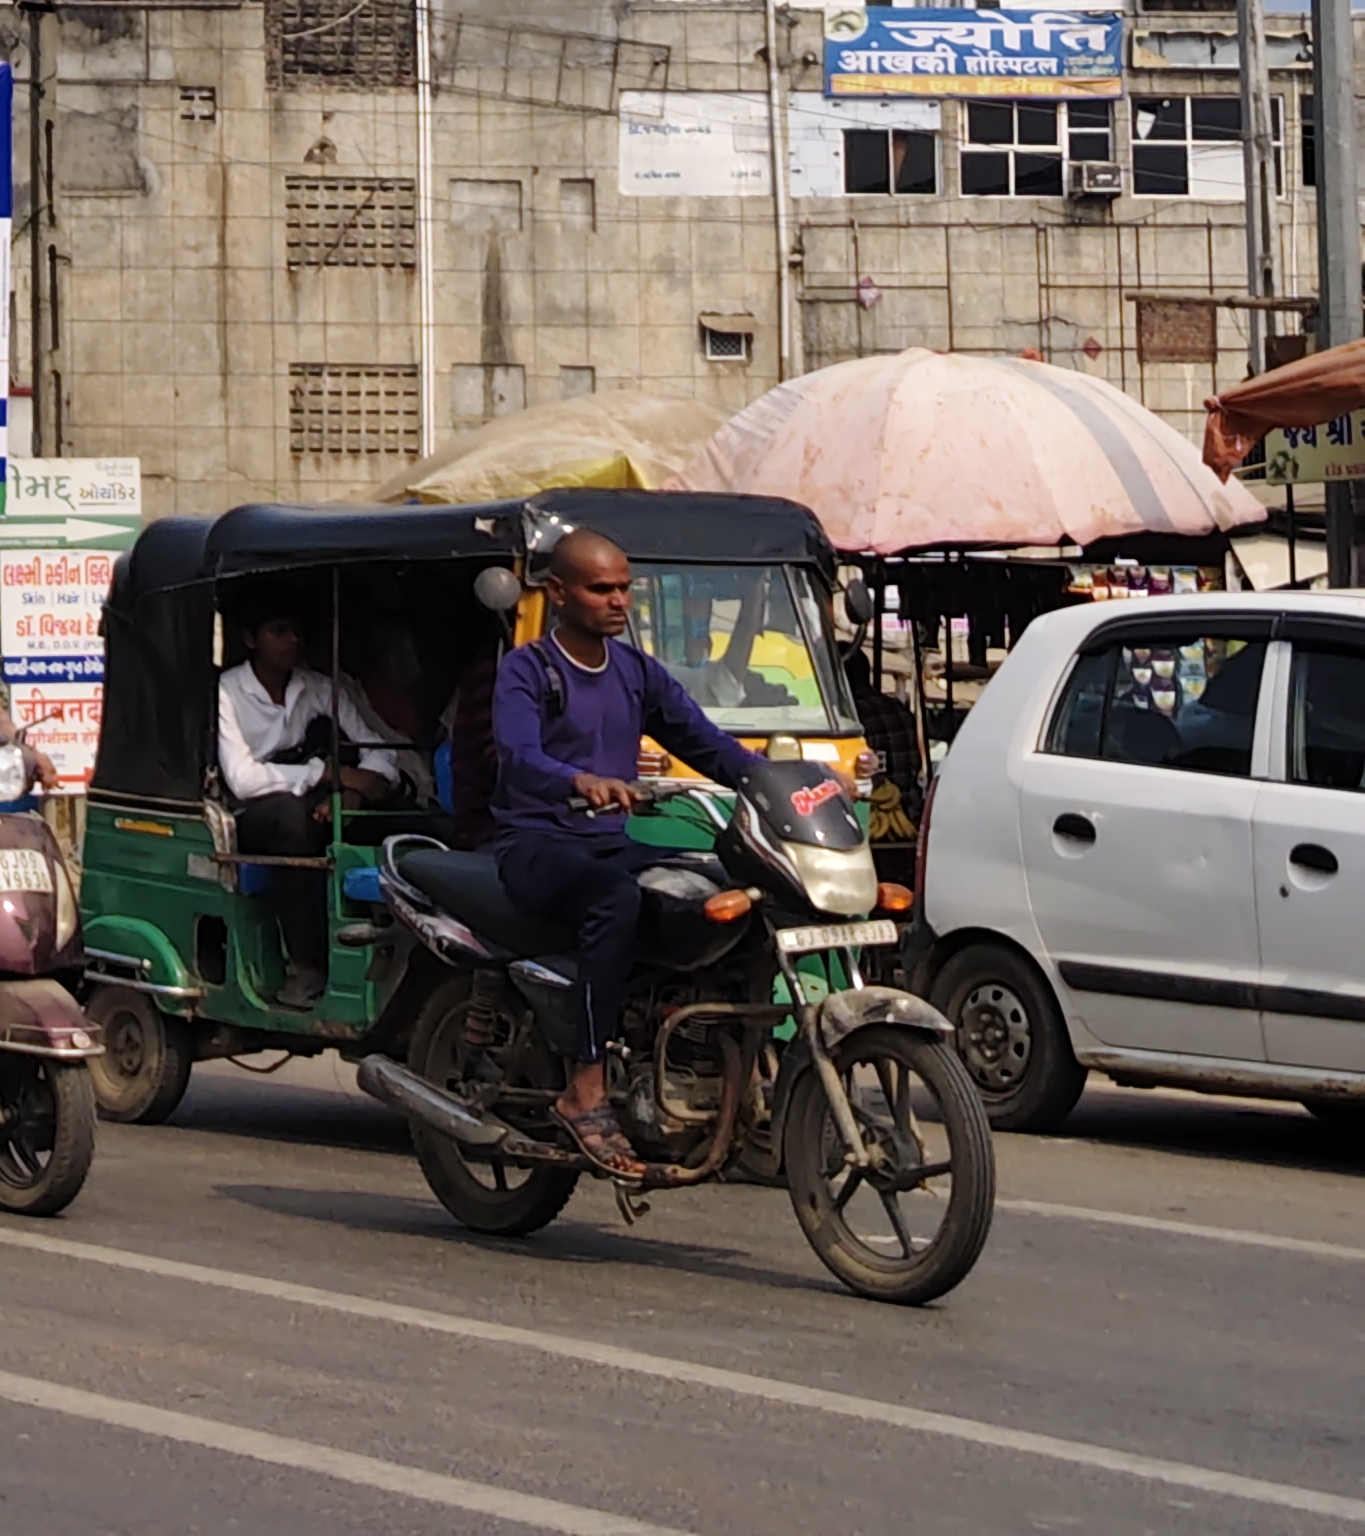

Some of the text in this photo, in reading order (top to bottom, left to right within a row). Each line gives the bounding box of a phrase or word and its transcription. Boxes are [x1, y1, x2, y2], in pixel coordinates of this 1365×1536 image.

[881, 10, 1112, 52] ज्योति
[21, 591, 46, 605] Skin
[57, 591, 80, 604] Hair
[39, 613, 82, 637] વિજય
[85, 612, 101, 636] દે
[15, 687, 103, 725] जीवनदी
